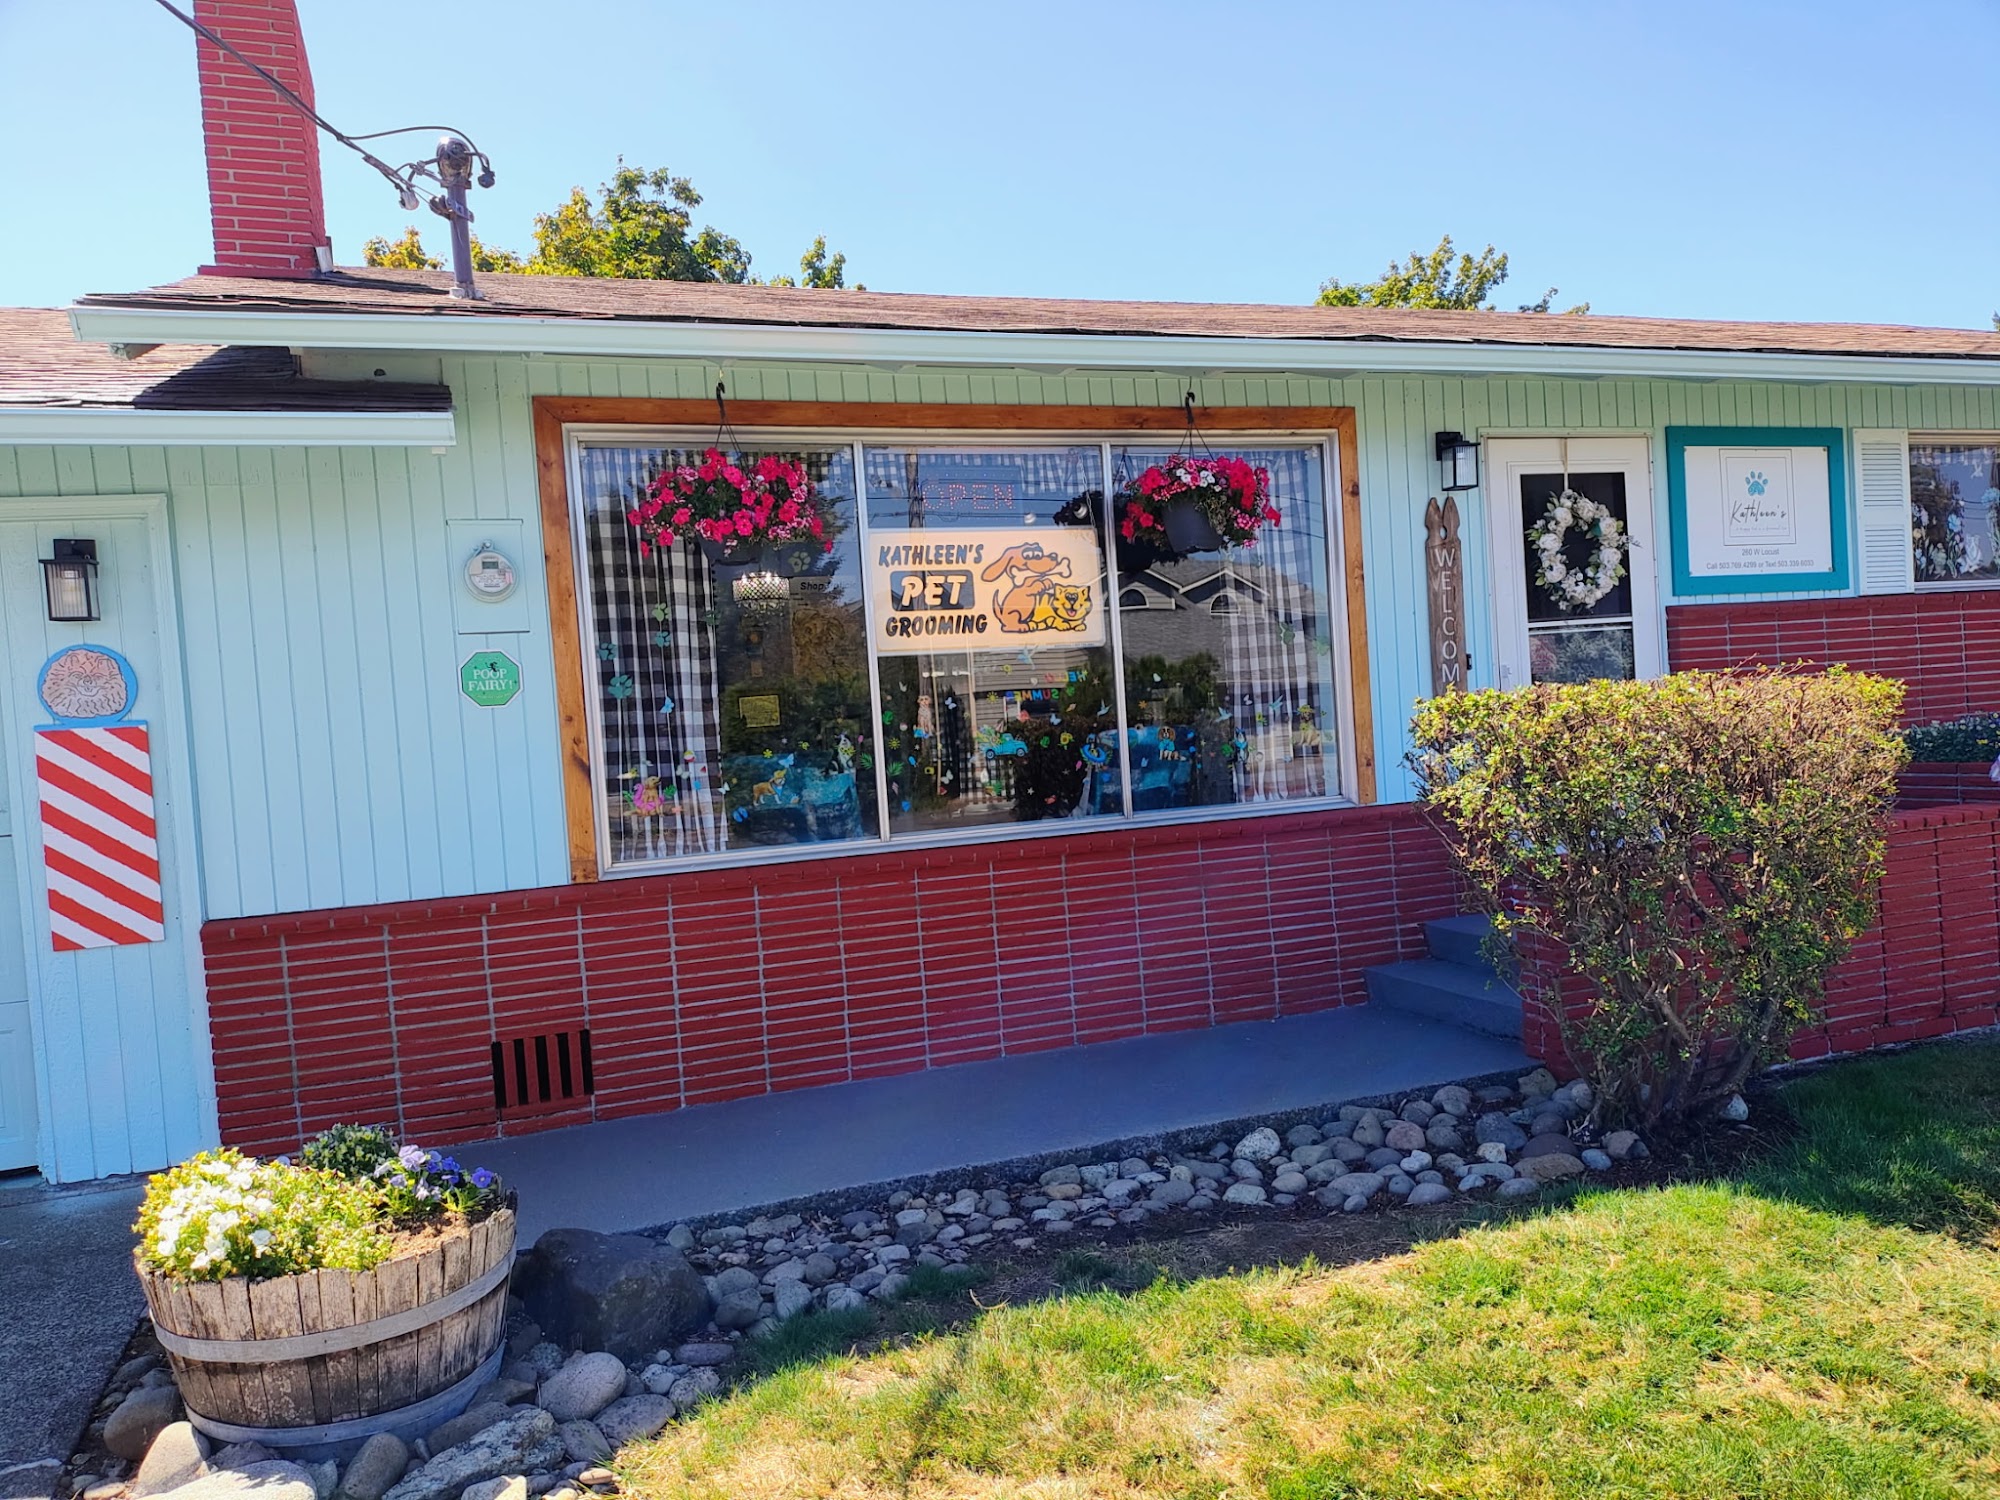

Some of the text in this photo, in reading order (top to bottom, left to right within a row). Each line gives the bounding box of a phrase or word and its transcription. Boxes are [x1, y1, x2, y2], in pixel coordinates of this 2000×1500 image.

[922, 484, 1016, 510] OPEN
[1730, 499, 1787, 525] Kathleen's
[879, 543, 984, 567] KATHLEEN'S
[1754, 548, 1760, 556] W
[1761, 548, 1780, 556] Locust
[1706, 562, 1718, 570] Call
[1765, 560, 1776, 568] Text
[800, 581, 825, 592] Shop
[901, 574, 967, 606] PET
[886, 614, 988, 638] GROOMING
[1435, 547, 1460, 683] WELCOM
[473, 668, 507, 680] POOP
